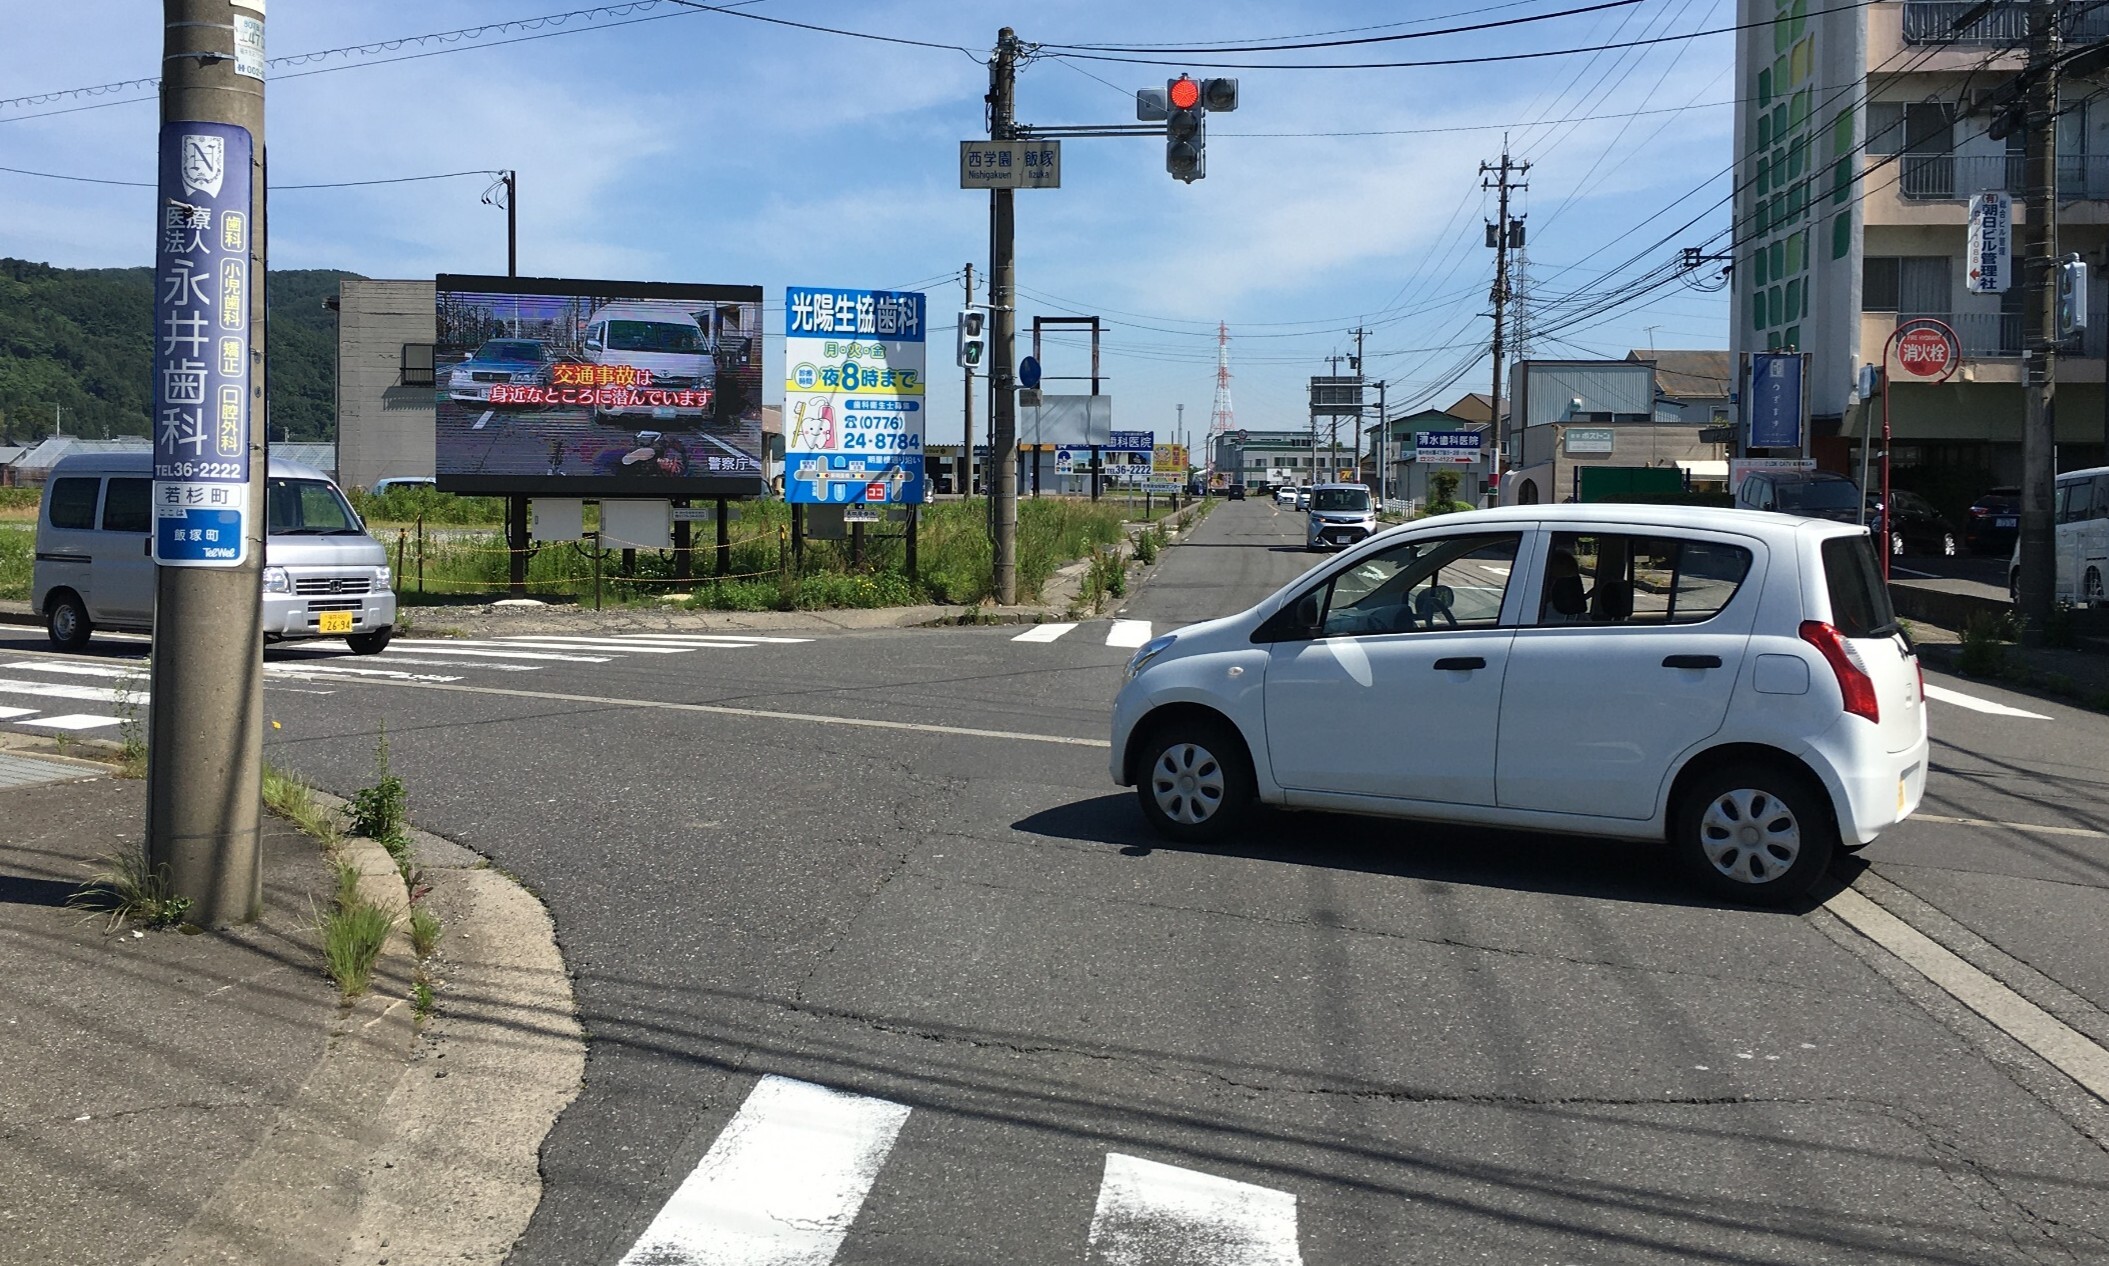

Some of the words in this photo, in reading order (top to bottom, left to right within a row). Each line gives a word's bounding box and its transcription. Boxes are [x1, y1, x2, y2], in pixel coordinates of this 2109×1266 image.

[968, 170, 1012, 181] Nishigakuen
[1028, 170, 1050, 179] Iizuka
[225, 216, 242, 249] 歯科
[223, 262, 241, 327] 小児歯科
[792, 292, 918, 336] 光陽生協歯科
[160, 258, 210, 456] 永井歯科
[222, 341, 240, 374] 矯正
[824, 342, 886, 359] 月・火・金
[1903, 344, 1945, 362] 消火栓
[553, 365, 653, 385] 交通事故は
[821, 362, 916, 391] 夜8時まで
[490, 386, 712, 406] 身近なところに潜んでいます
[220, 389, 239, 452] 口腔外科
[860, 416, 904, 430] (0776)
[844, 433, 920, 450] 24-8784
[1101, 436, 1152, 448] 歯科医院
[1419, 435, 1479, 446] 清水歯科医院
[1582, 432, 1610, 440] ボストン
[708, 456, 750, 471] 警察庁
[165, 486, 229, 505] 若杉町
[868, 488, 884, 497] ココ
[160, 508, 184, 517] ここは
[174, 528, 219, 542] 飯塚町
[202, 547, 236, 558] TelWel
[327, 621, 350, 630] 26-94
